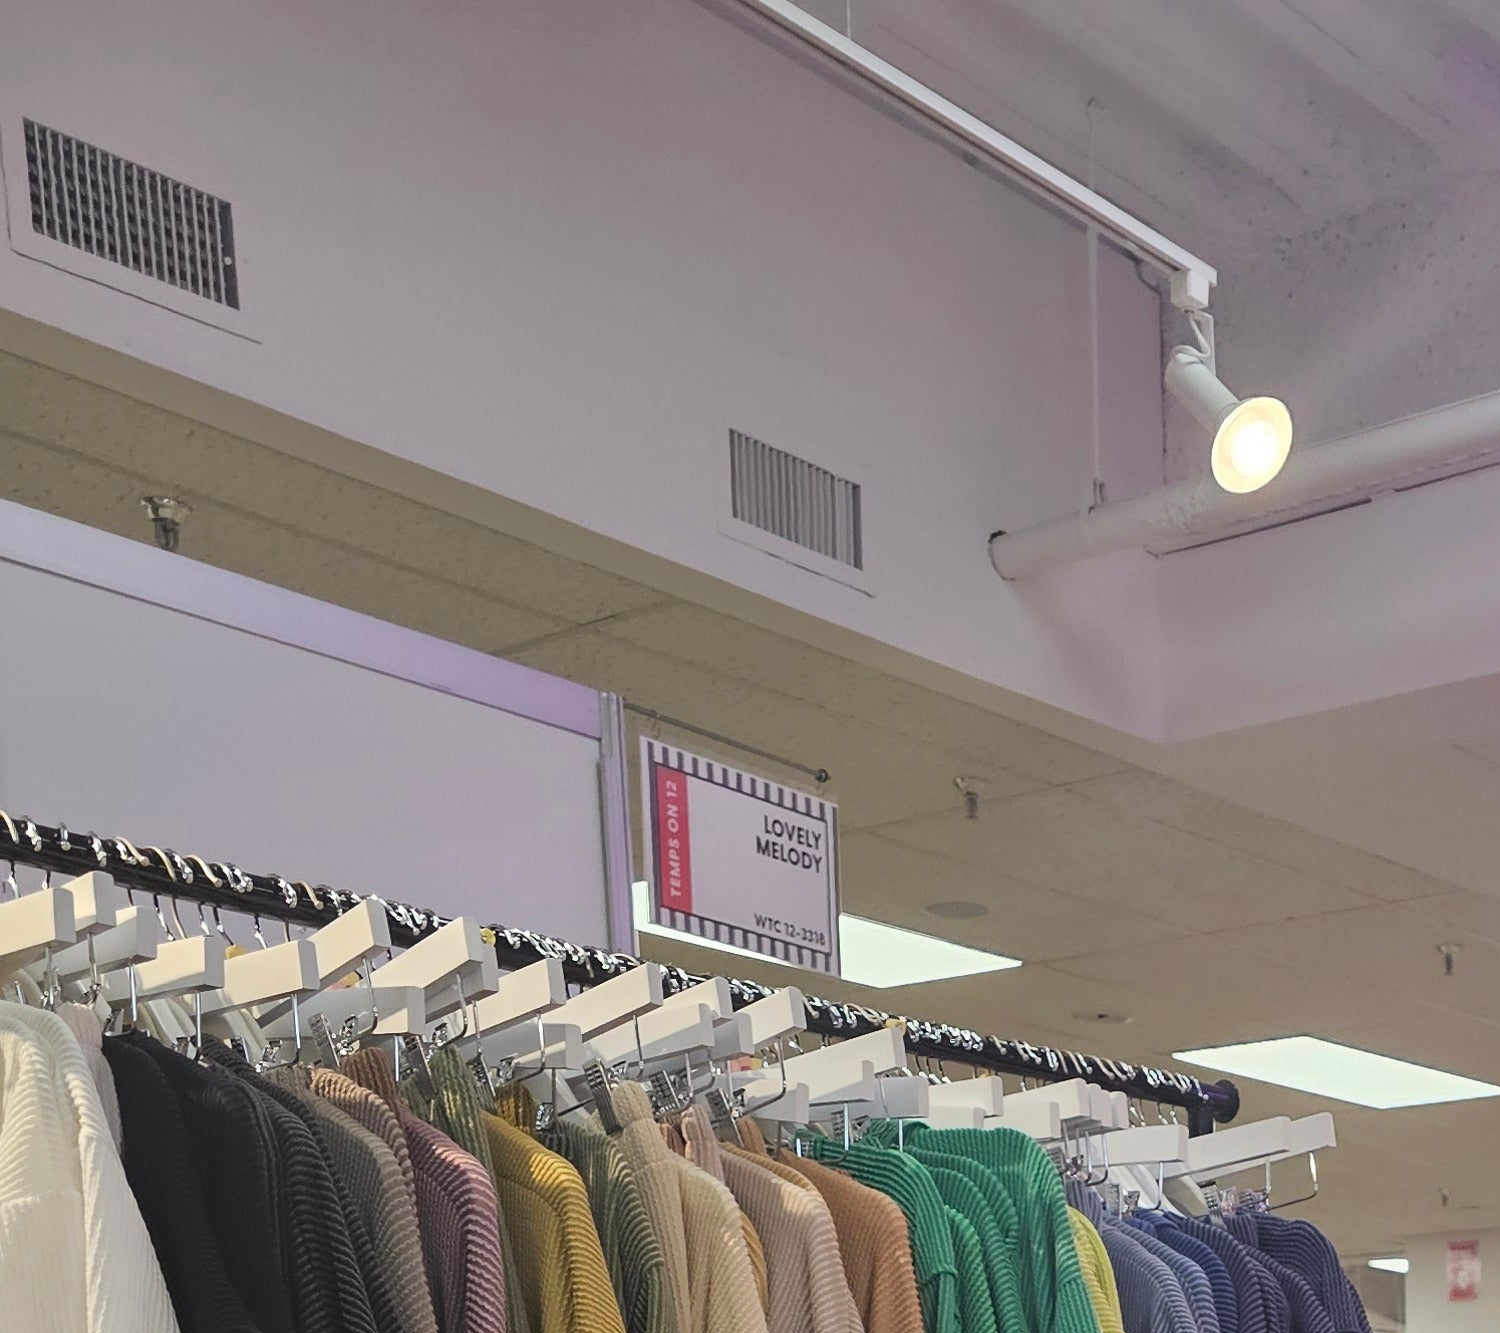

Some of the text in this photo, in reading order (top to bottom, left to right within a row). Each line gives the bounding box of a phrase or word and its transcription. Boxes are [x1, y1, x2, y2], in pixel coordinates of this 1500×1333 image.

[666, 780, 681, 897] TEMPS ON 12
[764, 815, 821, 850] LOVELY
[756, 836, 822, 873] MELODY
[754, 913, 781, 934] WTC
